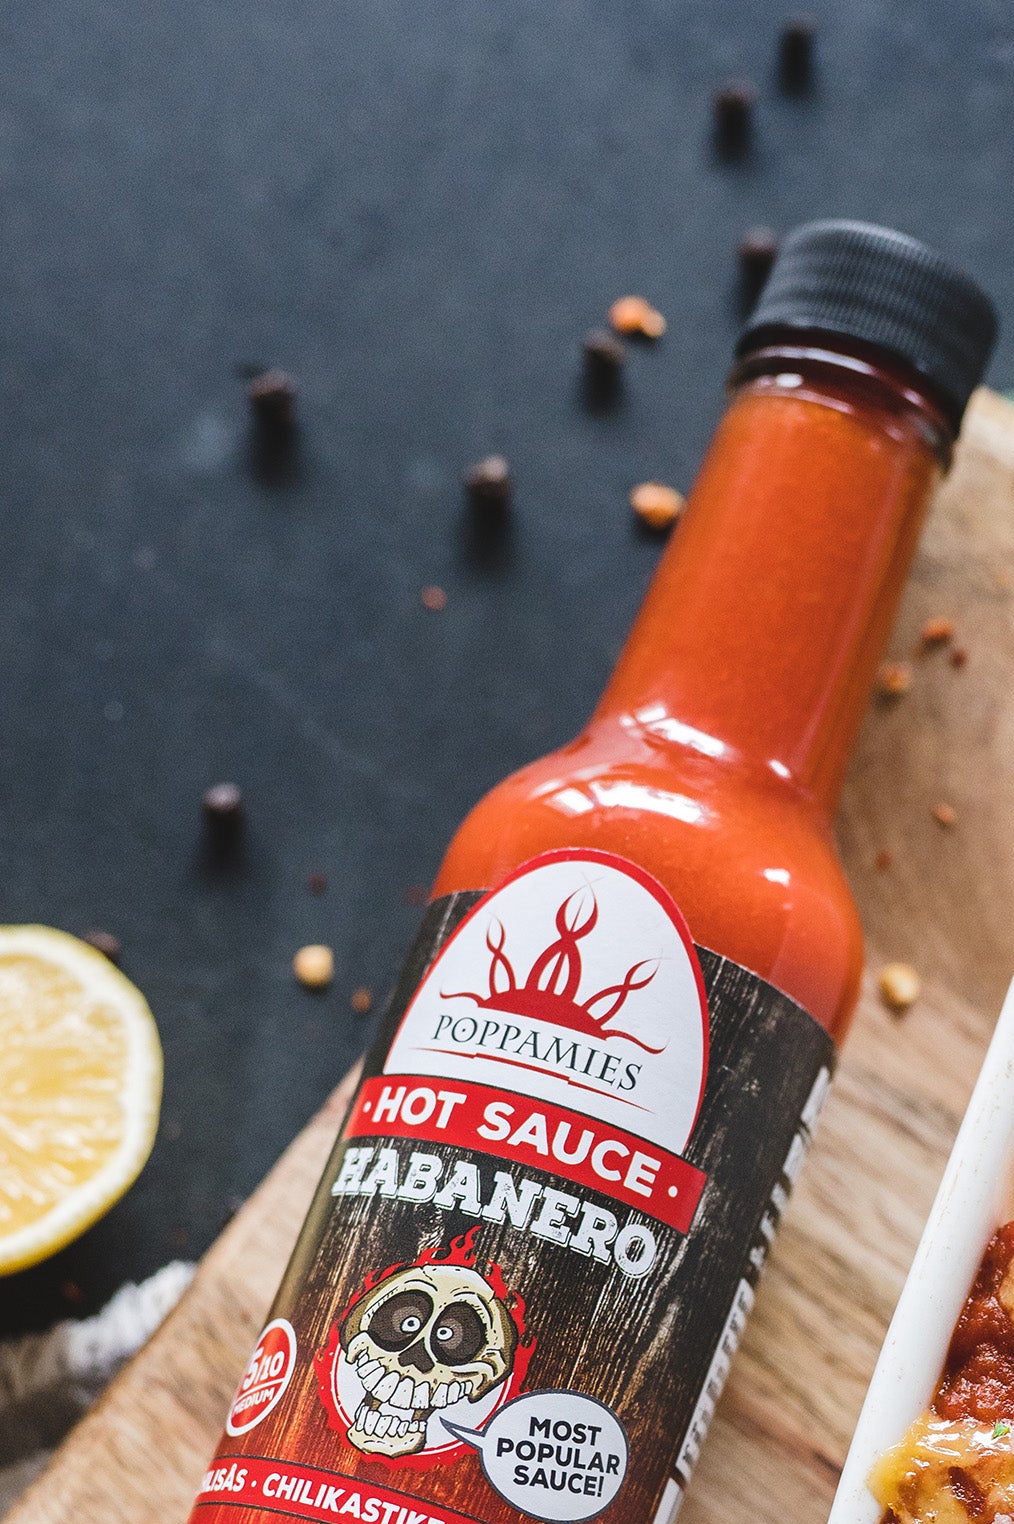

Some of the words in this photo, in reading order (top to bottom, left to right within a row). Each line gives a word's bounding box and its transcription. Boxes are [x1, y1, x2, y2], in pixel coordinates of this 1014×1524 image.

[432, 1014, 642, 1091] POPPAMIES
[372, 1086, 467, 1129] HOT
[477, 1101, 661, 1198] SAUCE
[332, 1147, 656, 1277] HABANERO
[243, 1347, 285, 1390] 5/10
[529, 1416, 602, 1446] MOST
[496, 1437, 620, 1475] POPULAR
[512, 1464, 605, 1498] SAUCE!
